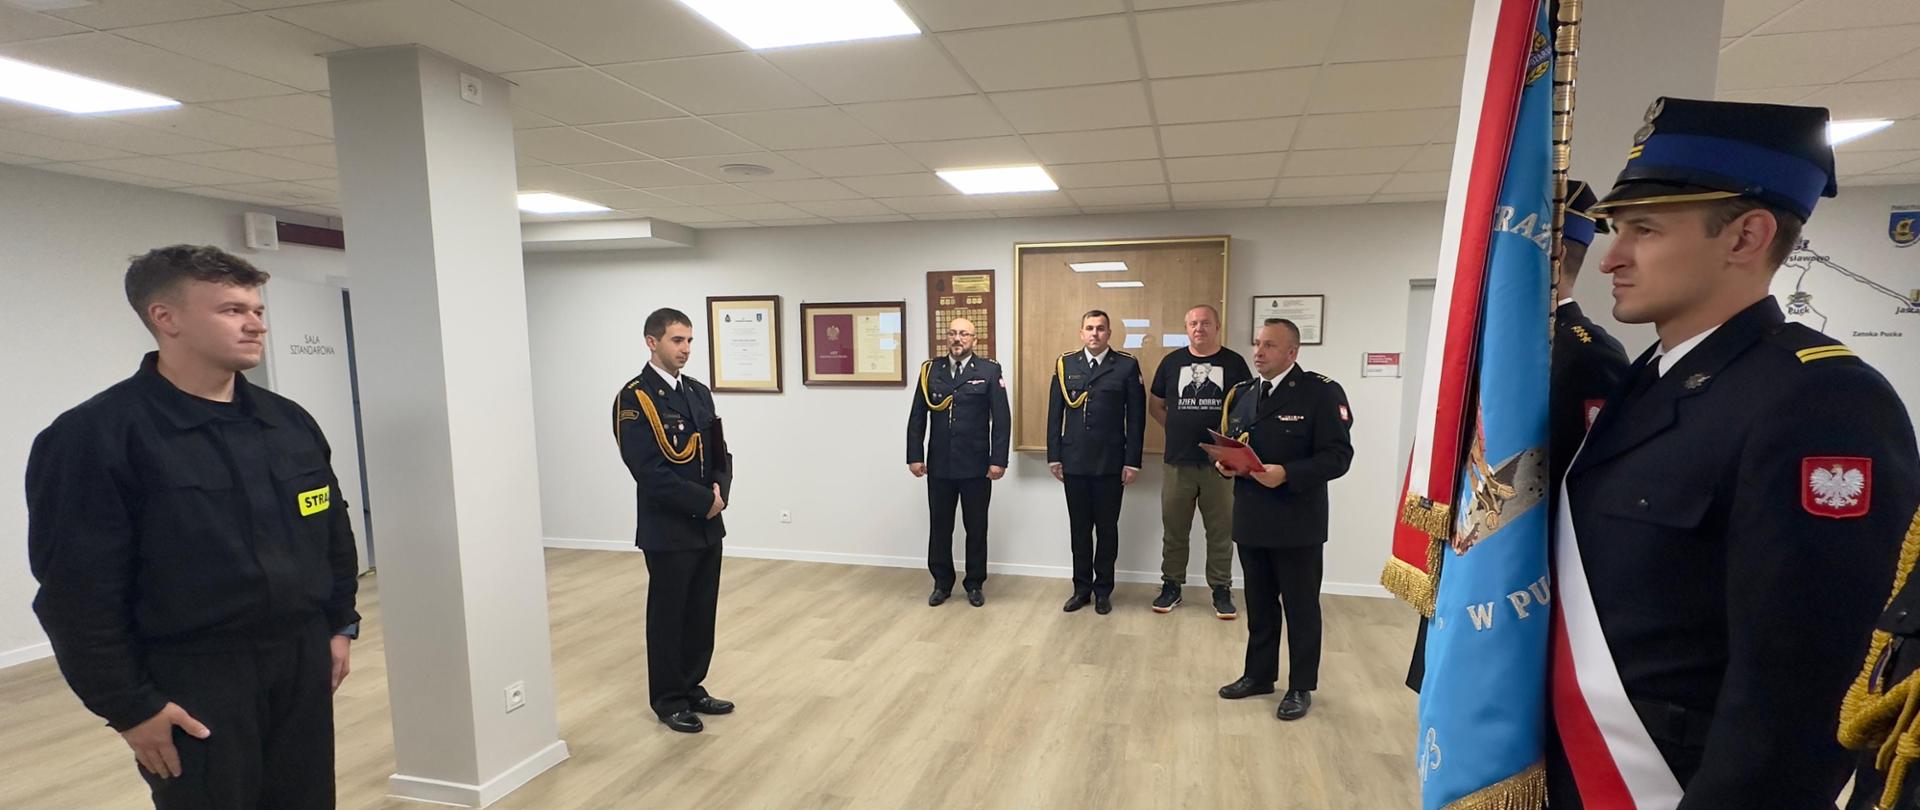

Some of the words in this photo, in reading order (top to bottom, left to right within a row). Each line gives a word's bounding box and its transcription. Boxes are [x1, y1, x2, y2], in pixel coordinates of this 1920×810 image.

[1788, 305, 1810, 315] Puck
[304, 334, 320, 345] SALA
[290, 344, 335, 356] SZTANDAROWA
[1466, 601, 1495, 631] W
